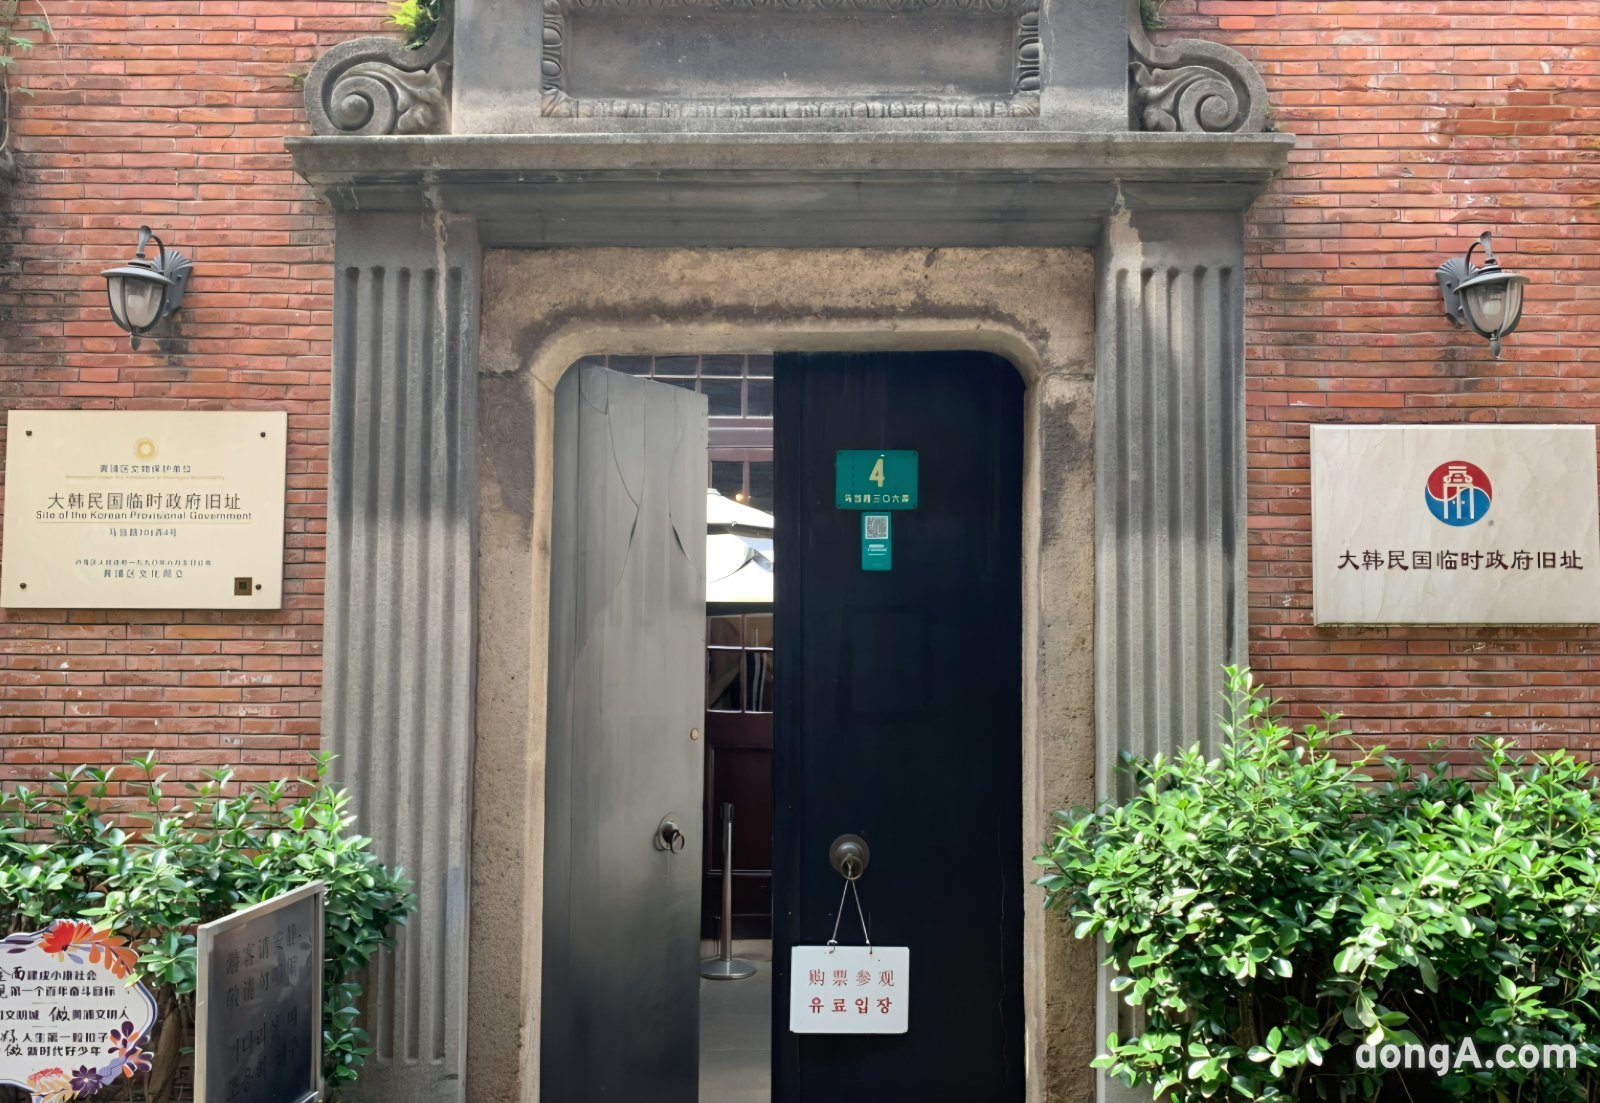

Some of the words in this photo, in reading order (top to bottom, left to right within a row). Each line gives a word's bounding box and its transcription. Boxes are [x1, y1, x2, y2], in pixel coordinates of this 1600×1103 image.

[868, 458, 885, 487] 4
[47, 492, 242, 510] 大韩民国临时政府旧址
[36, 511, 55, 520] Site
[58, 511, 68, 520] of
[71, 511, 87, 520] the
[90, 511, 127, 520] Korean
[189, 511, 252, 520] Government
[1337, 549, 1584, 571] 大韩民国临时政府旧址
[809, 969, 894, 986] 购票参观
[808, 997, 892, 1014] 유료입장
[0, 1010, 40, 1020] 文明城
